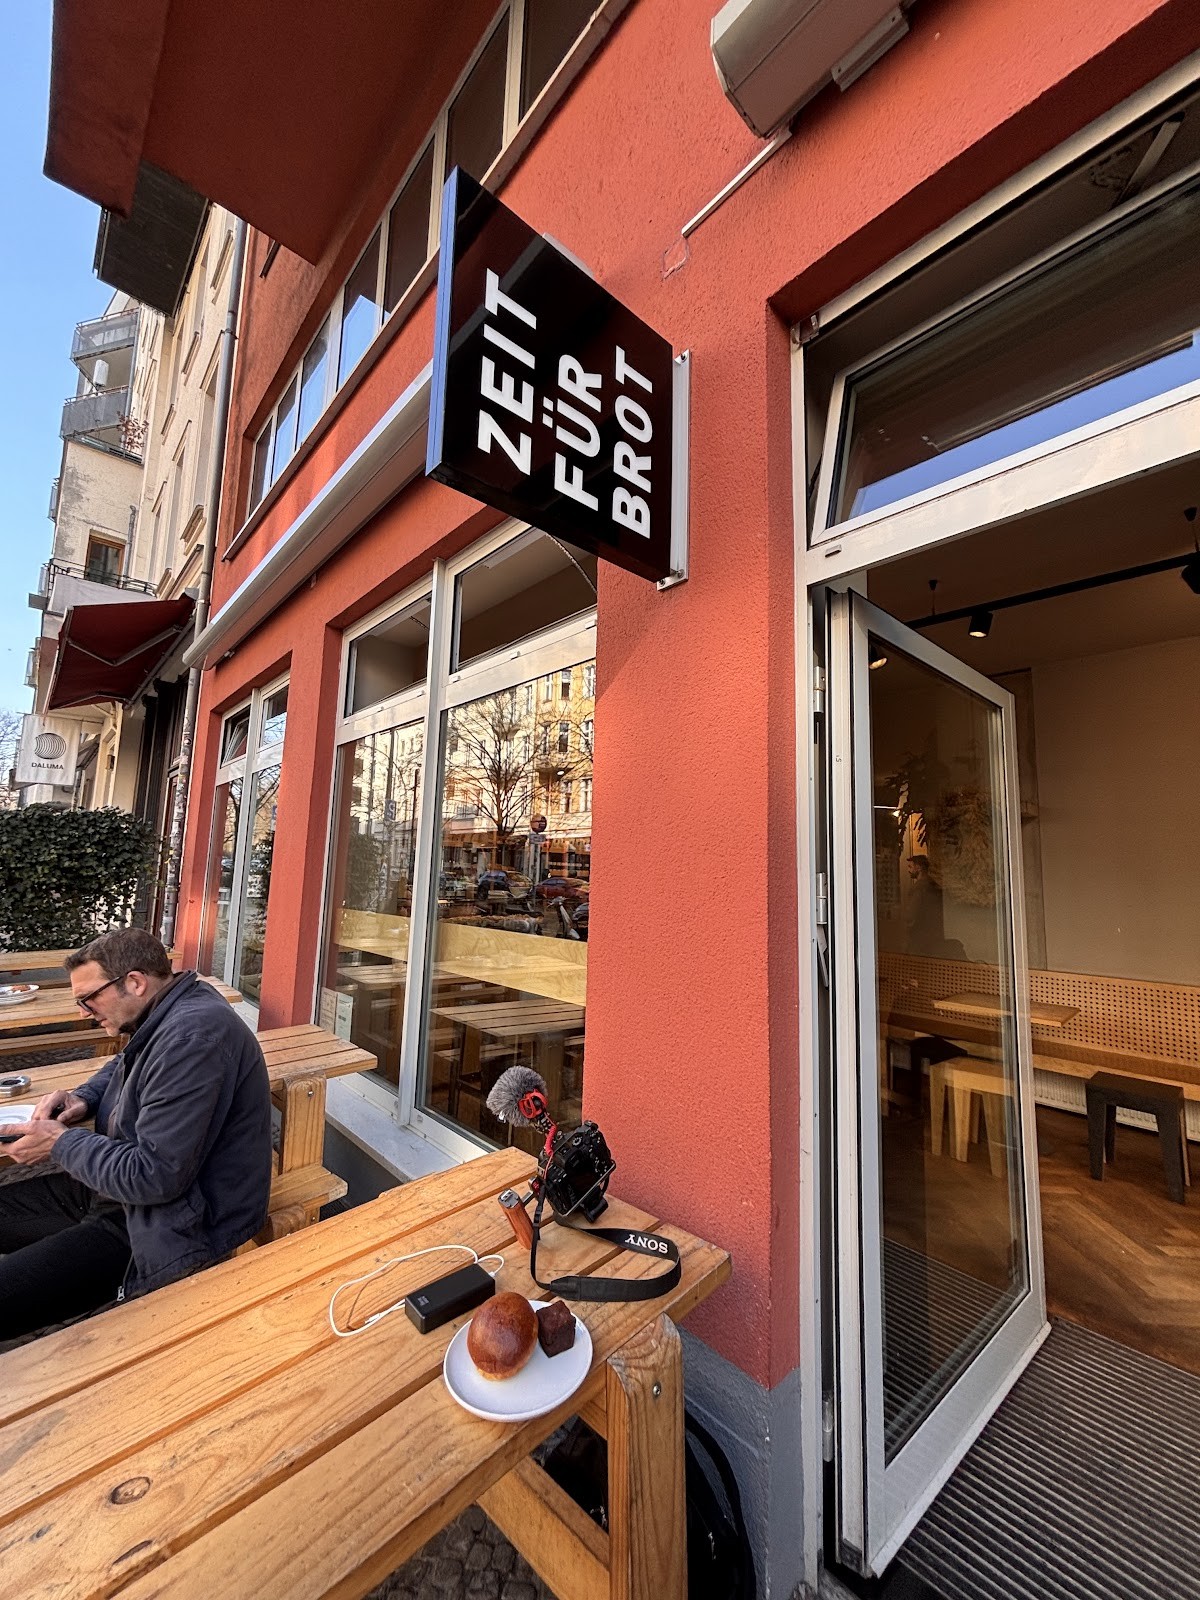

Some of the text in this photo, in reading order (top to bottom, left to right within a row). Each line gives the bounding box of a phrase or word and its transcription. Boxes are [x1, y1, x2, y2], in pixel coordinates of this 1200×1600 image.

[477, 268, 537, 476] ZEIT
[541, 354, 602, 511] FÜR
[611, 345, 653, 539] BROT
[31, 762, 64, 770] DALUMA
[624, 1233, 668, 1254] SONY
